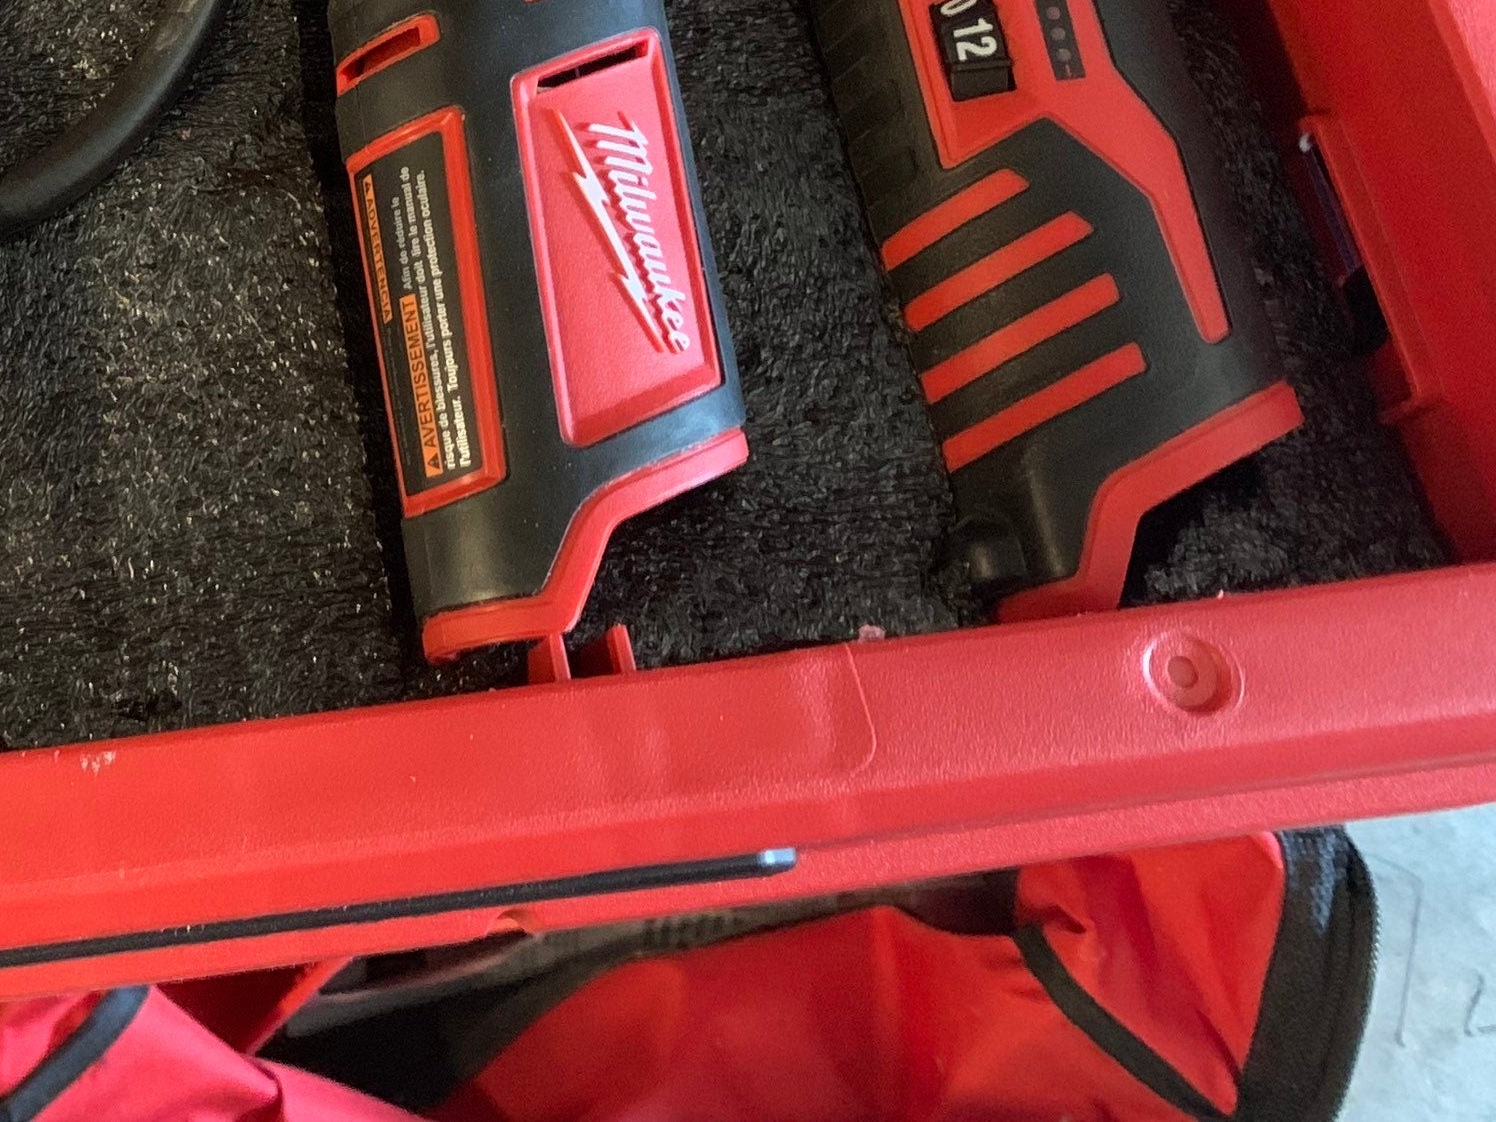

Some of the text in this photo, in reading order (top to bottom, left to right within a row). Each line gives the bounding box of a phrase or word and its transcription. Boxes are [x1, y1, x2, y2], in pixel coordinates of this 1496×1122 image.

[953, 18, 998, 62] 12
[399, 166, 410, 182] de
[391, 197, 400, 209] le
[408, 225, 418, 237] le
[578, 111, 690, 353] Milwaukee
[367, 198, 391, 320] ADVERTENCIA
[399, 250, 408, 264] de
[414, 260, 425, 284] doit
[402, 266, 413, 290] Afin
[415, 169, 472, 468] l'utilisateur. Toujours porter une protection oculaire.
[419, 285, 436, 349] l'utilisateur
[402, 300, 437, 448] AVERTISSEMENT
[429, 349, 447, 412] blessures,
[438, 412, 449, 429] de
[444, 430, 456, 470] risque
